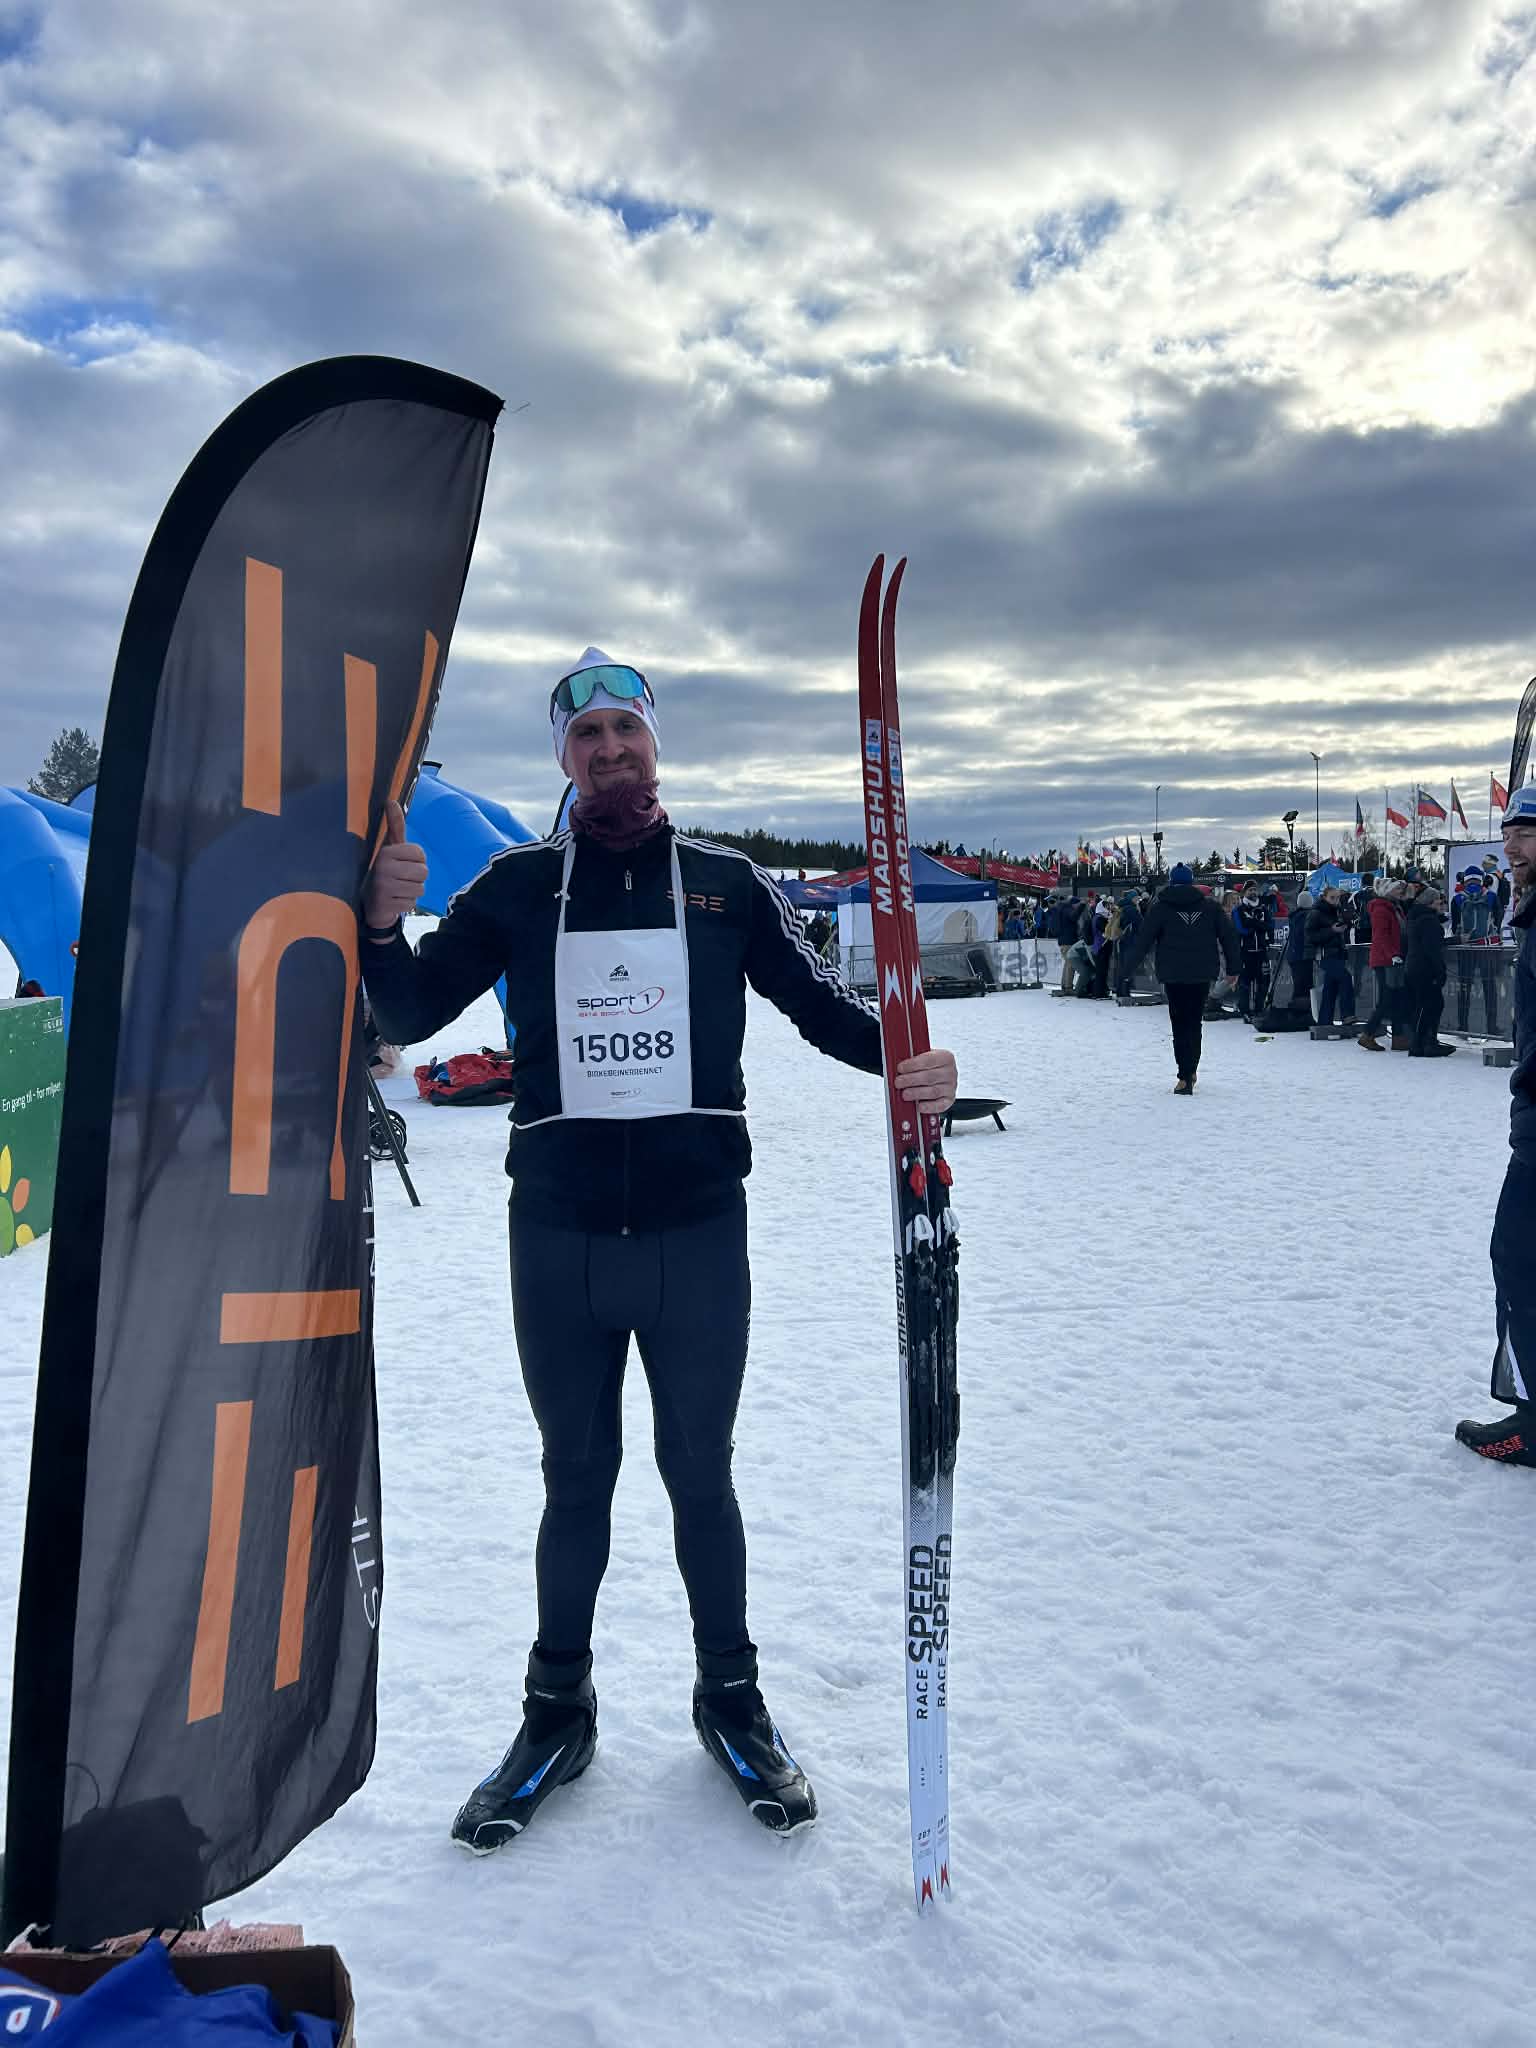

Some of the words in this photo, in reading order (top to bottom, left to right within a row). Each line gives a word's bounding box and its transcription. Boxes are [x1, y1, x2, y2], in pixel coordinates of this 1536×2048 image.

[867, 759, 893, 915] MADSHU
[892, 786, 914, 913] MADSH
[577, 994, 636, 1011] sport
[643, 993, 650, 1005] 1
[573, 1030, 674, 1064] 15088
[2, 1098, 11, 1112] En
[11, 1095, 26, 1113] gang
[36, 1087, 45, 1099] for
[895, 1254, 907, 1356] MADSHUS
[908, 1547, 934, 1664] SPEED
[931, 1533, 953, 1652] SPEED
[915, 1668, 929, 1720] RACE
[936, 1656, 947, 1707] RACE
